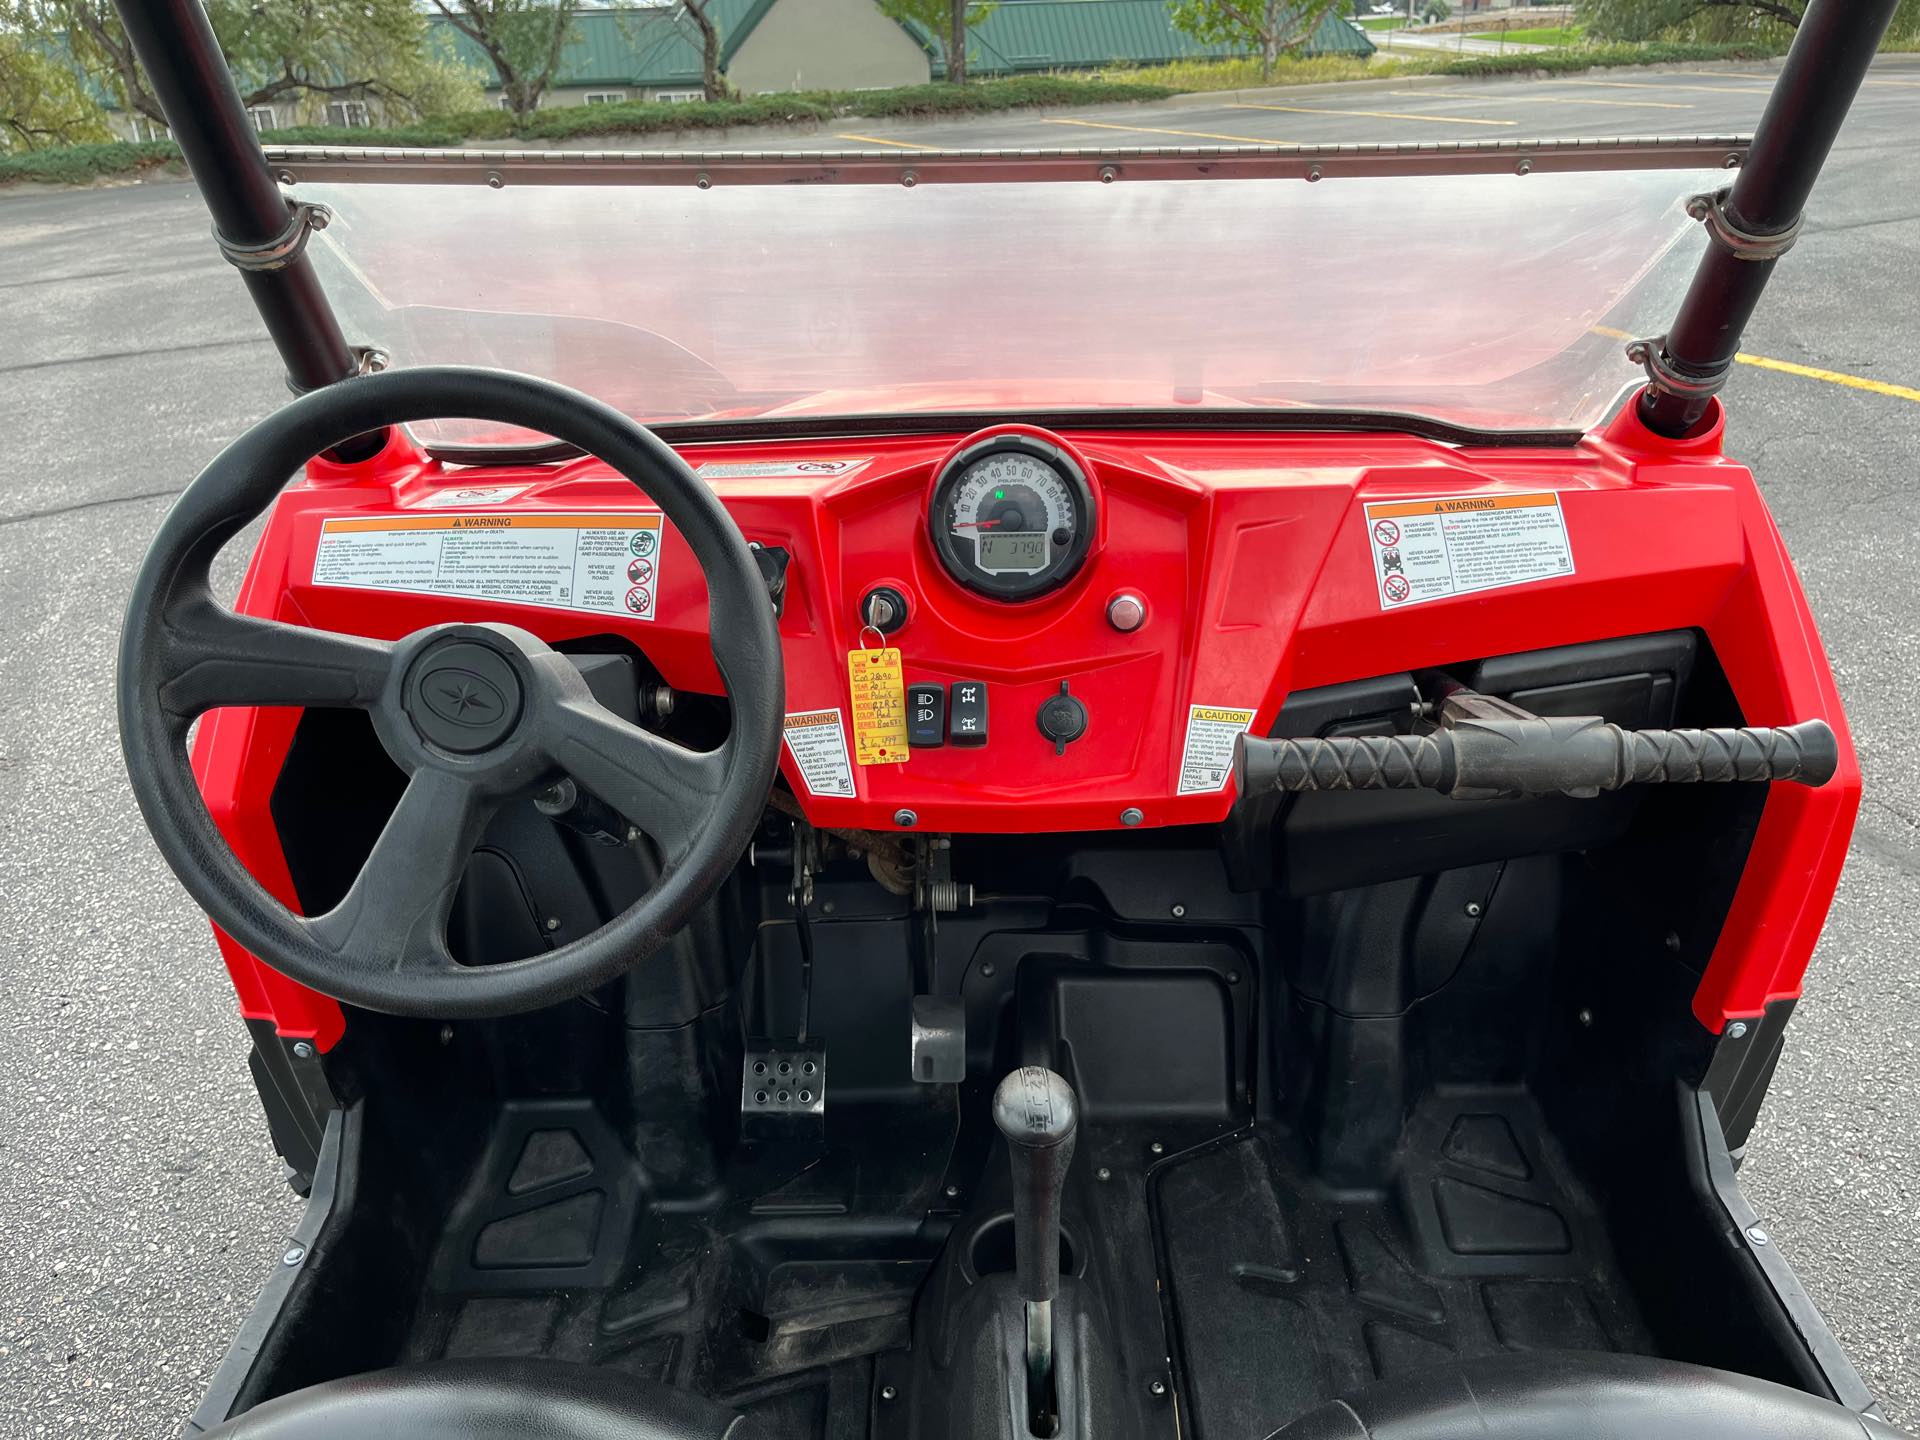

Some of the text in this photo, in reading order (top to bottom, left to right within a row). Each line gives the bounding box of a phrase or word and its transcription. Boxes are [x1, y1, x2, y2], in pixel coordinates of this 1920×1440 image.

[991, 467, 1002, 478] 40
[1007, 466, 1016, 475] 50
[1021, 467, 1033, 479] 60
[976, 475, 988, 488] 30
[1035, 475, 1047, 487] 70
[966, 488, 976, 500] 20
[1046, 485, 1057, 498] 80
[961, 504, 970, 512] 10
[1446, 500, 1495, 512] WARNING
[465, 518, 511, 526] WARNING
[982, 540, 1043, 554] N 3790
[791, 714, 837, 726] WARNING
[1205, 711, 1245, 721] CAUTION
[1033, 1096, 1043, 1105] L
